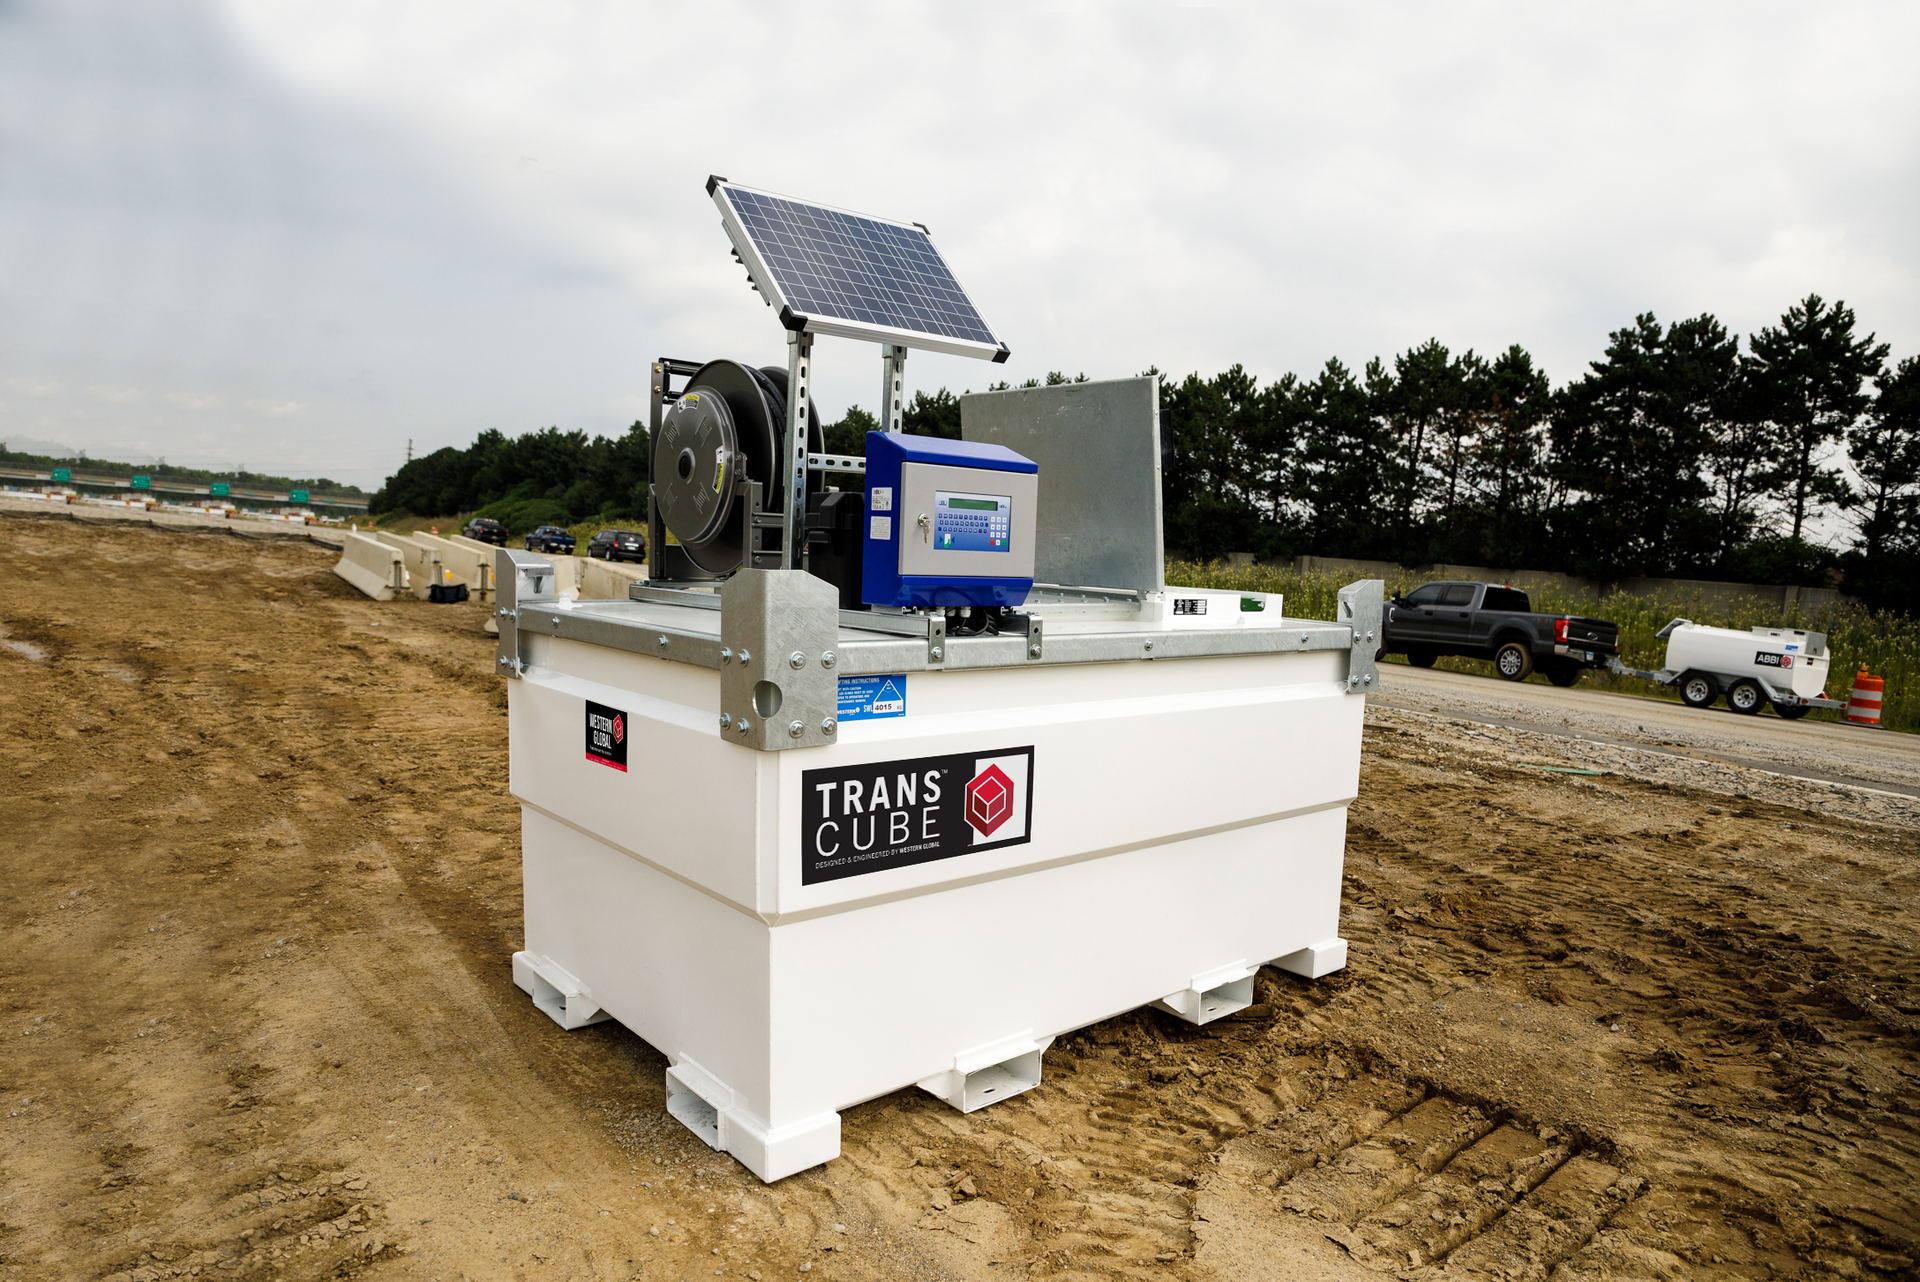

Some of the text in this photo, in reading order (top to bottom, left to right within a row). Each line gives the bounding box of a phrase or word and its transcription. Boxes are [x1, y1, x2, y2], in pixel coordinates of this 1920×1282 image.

[1757, 654, 1779, 664] ABBI
[589, 713, 612, 734] WESTERN
[594, 730, 612, 749] GLOBAL
[816, 770, 941, 818] TRANS
[815, 805, 940, 857] CUBE
[815, 857, 845, 869] DESIGNED
[853, 849, 890, 862] ENGINEERED
[899, 843, 922, 853] WESTERN
[923, 841, 940, 849] GLOBAL
